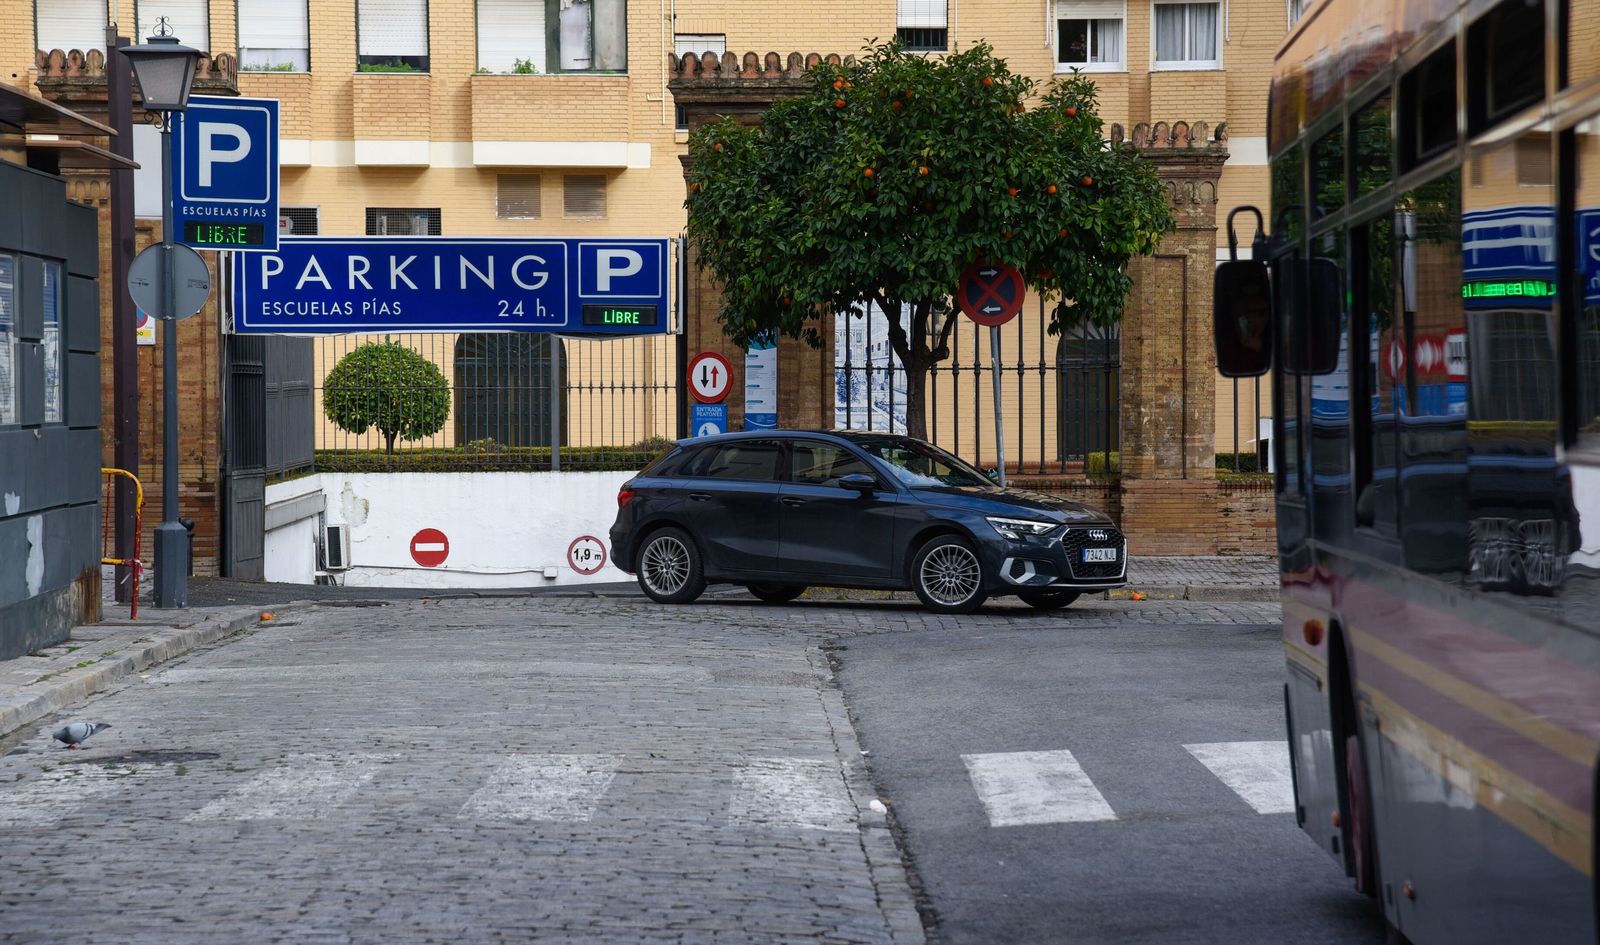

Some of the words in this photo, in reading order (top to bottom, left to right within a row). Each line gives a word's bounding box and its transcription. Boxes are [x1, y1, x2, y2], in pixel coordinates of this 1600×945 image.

[198, 121, 252, 187] P
[183, 206, 239, 216] ESCUELAS
[243, 207, 267, 218] PÍAS
[197, 225, 247, 244] LIBRE
[261, 254, 549, 290] PARKING
[596, 248, 643, 291] P
[262, 301, 353, 315] ESCUELAS
[362, 298, 402, 315] PÍAS
[498, 299, 525, 317] 24
[536, 298, 555, 317] h.
[604, 309, 640, 324] LIBRE
[573, 548, 590, 562] 1,9
[1086, 549, 1103, 560] 7342
